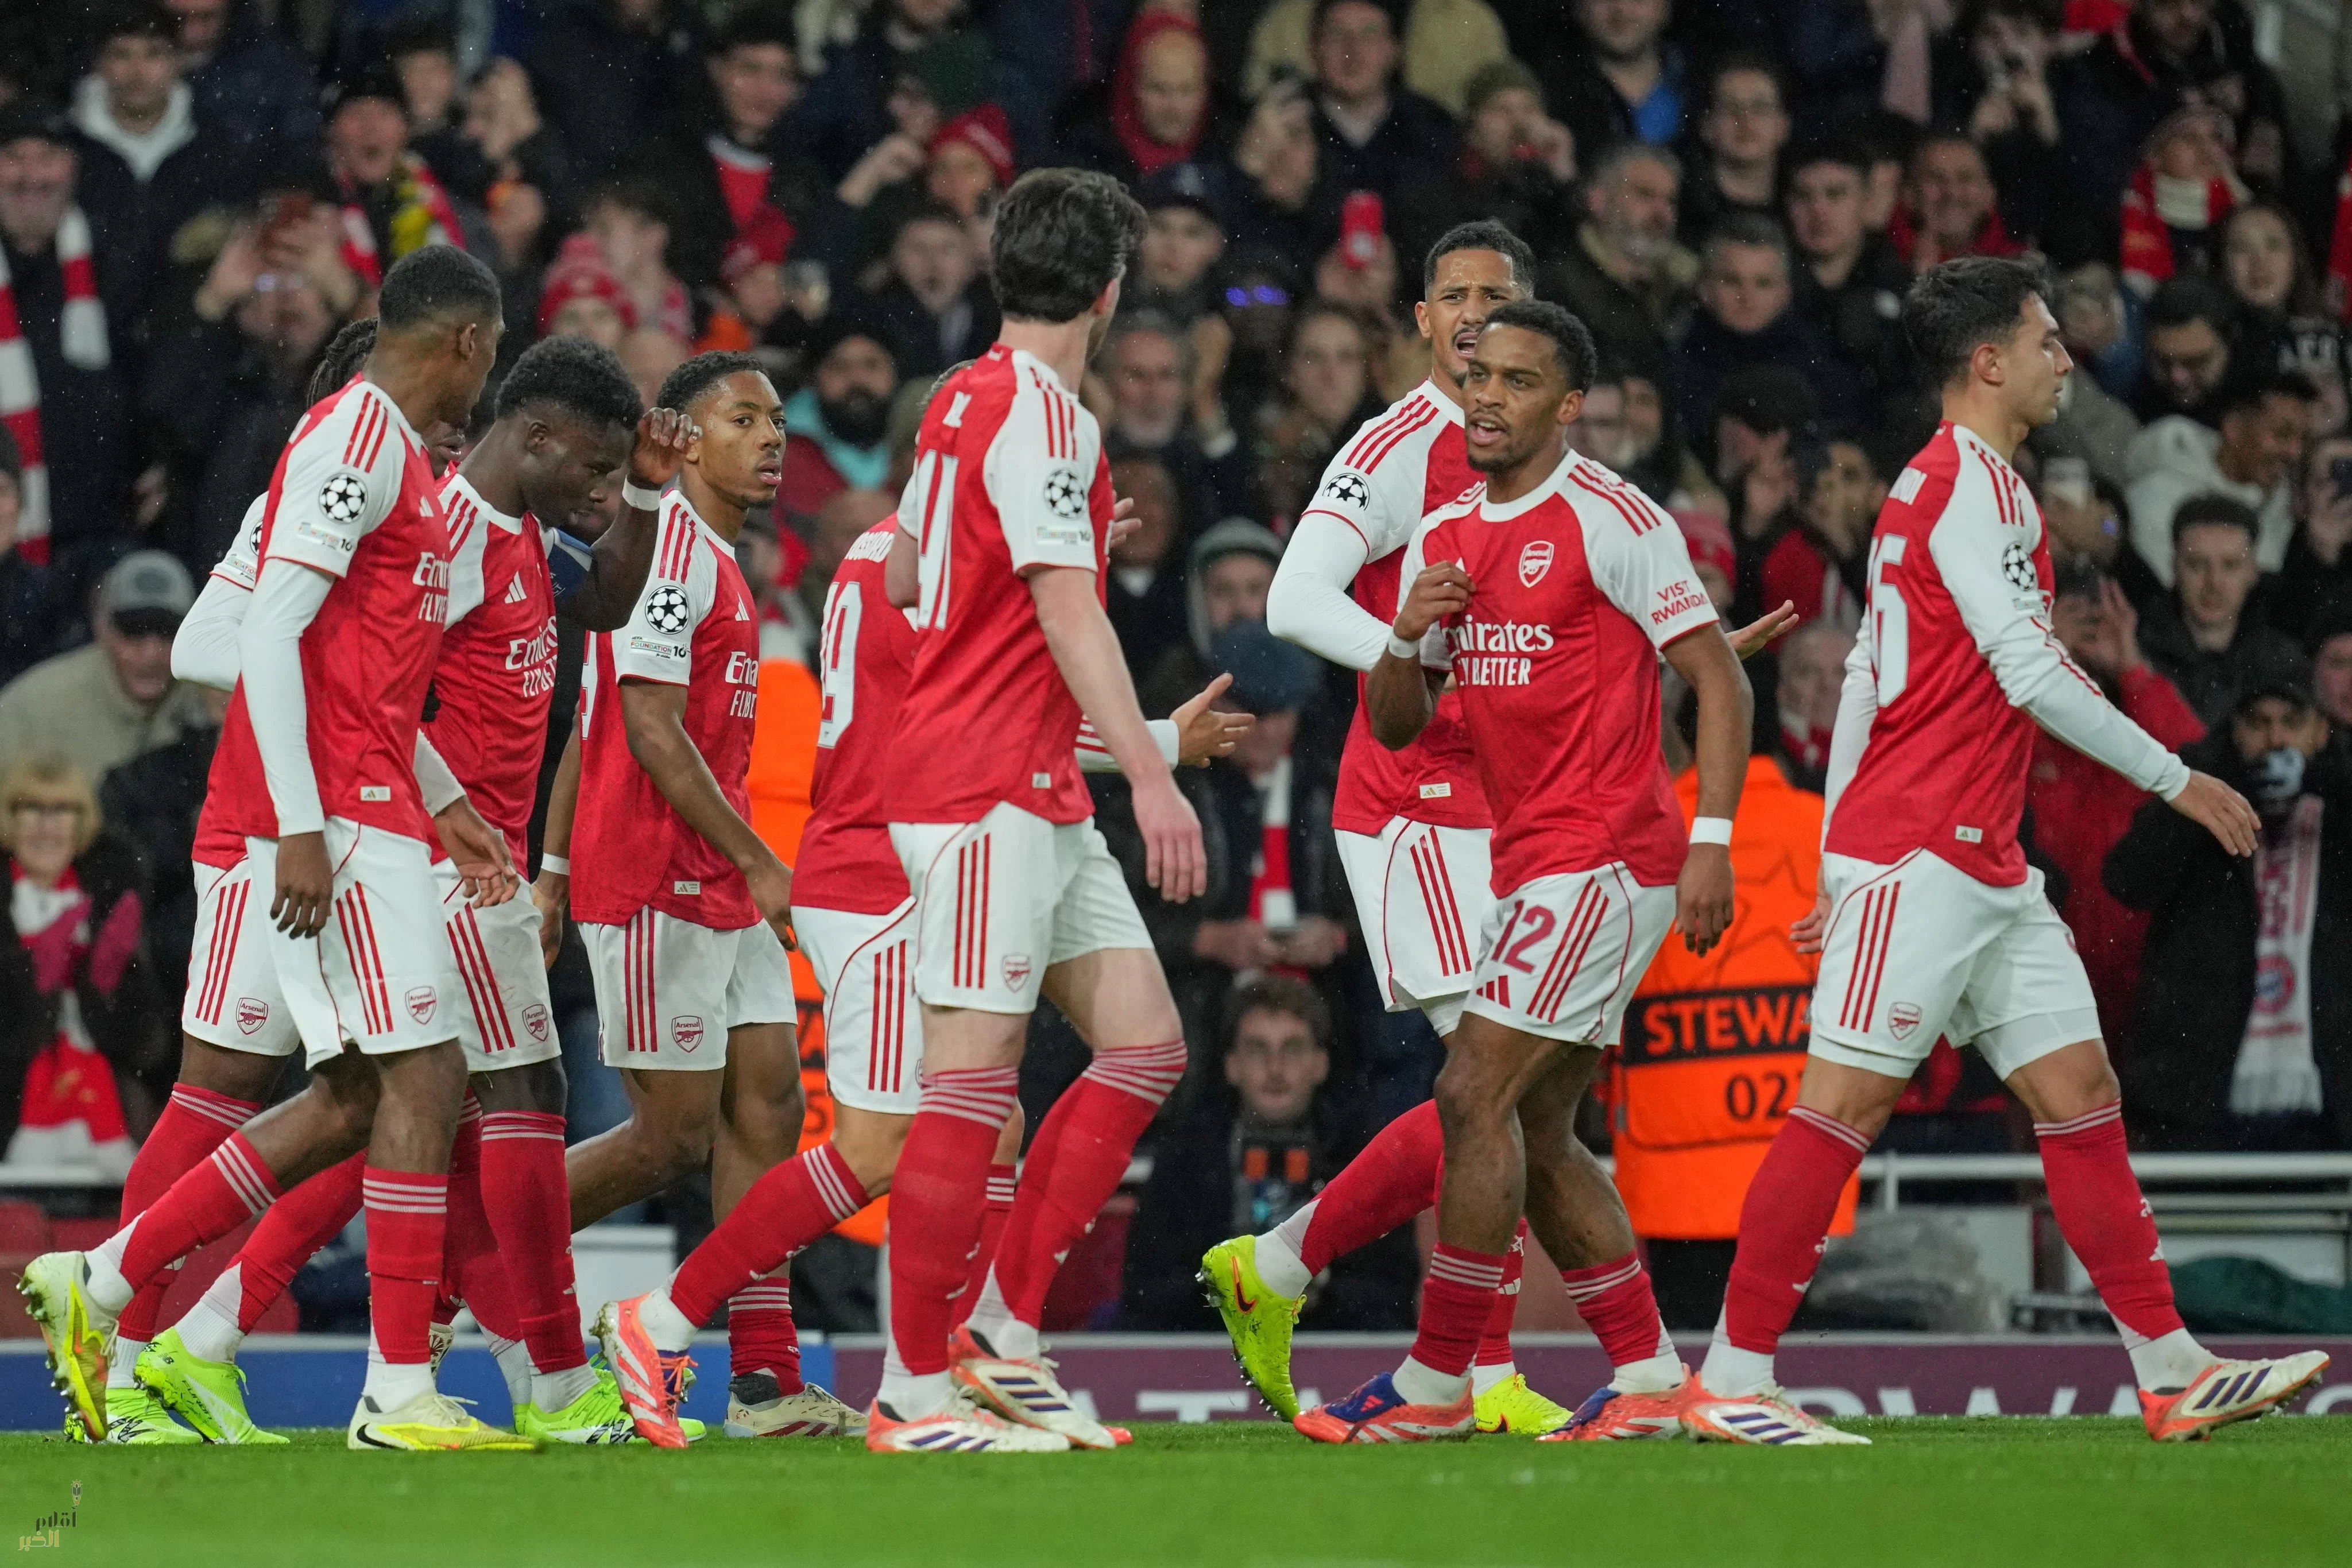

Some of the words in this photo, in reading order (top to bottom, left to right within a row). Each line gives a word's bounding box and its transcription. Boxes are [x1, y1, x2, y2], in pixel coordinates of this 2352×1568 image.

[630, 642, 672, 653] FOUNDATION
[1446, 614, 1554, 653] mirates
[1472, 656, 1531, 686] BETTER
[1491, 899, 1557, 974] 12
[241, 1003, 264, 1013] Arsenal
[1643, 993, 1811, 1056] STEWA
[1726, 1070, 1804, 1123] 02
